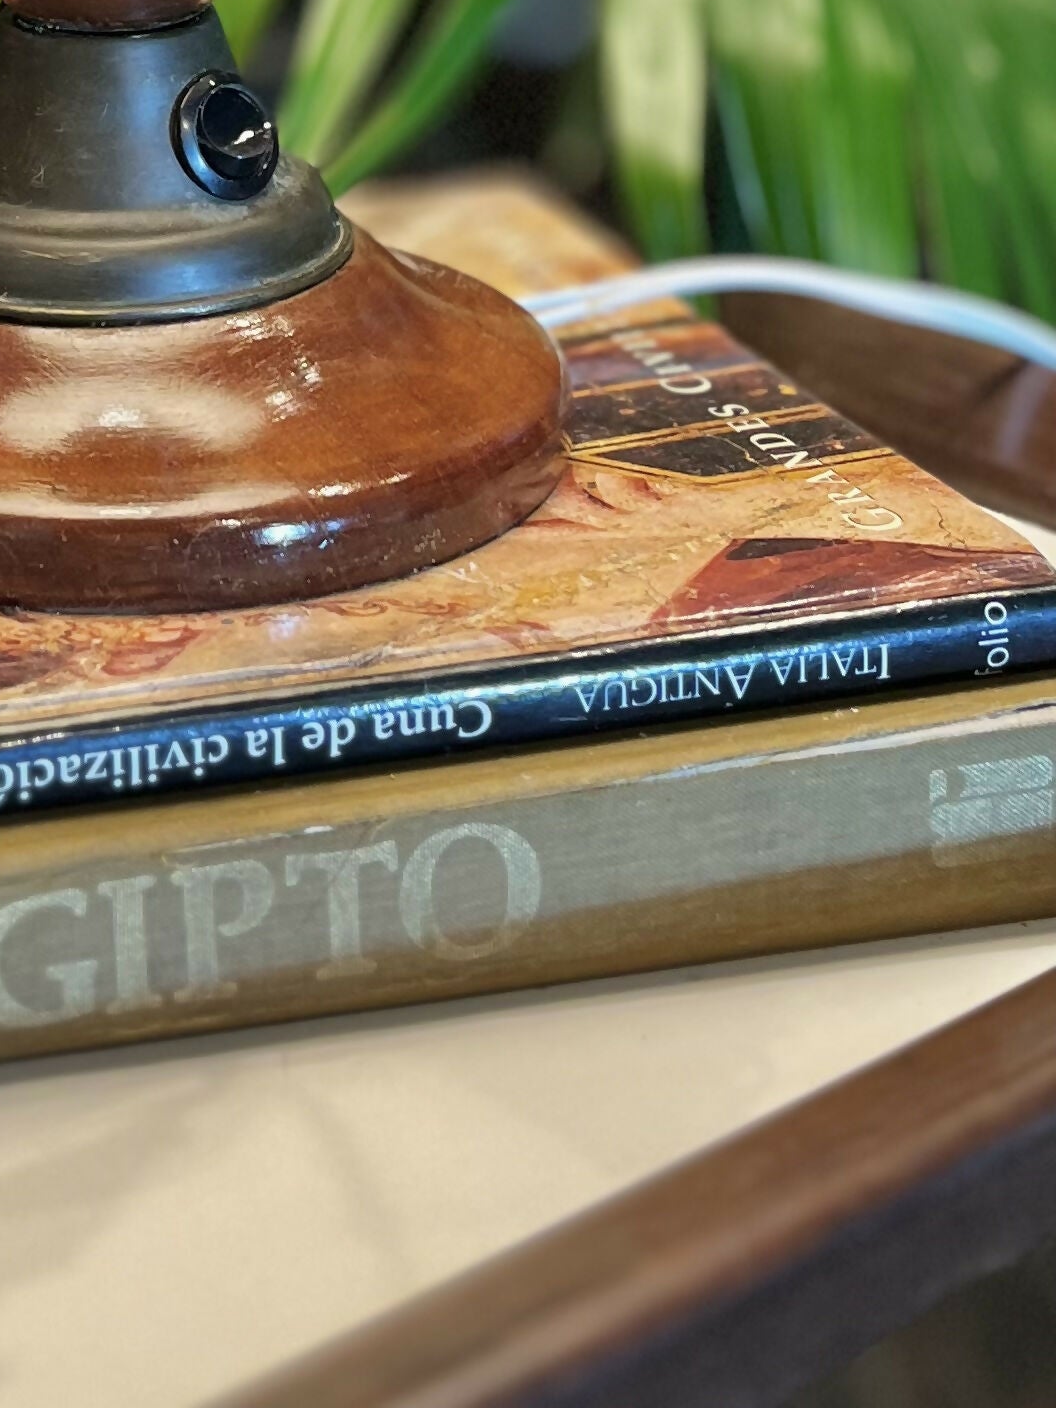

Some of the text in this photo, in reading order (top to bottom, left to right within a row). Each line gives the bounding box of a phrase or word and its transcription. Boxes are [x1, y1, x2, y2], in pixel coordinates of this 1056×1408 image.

[707, 403, 904, 532] GRANDES
[973, 600, 1011, 677] folio
[575, 643, 892, 713] ITALIA ANTIGUA
[244, 726, 287, 766] la
[301, 716, 357, 758] de
[373, 699, 494, 739] Cuna
